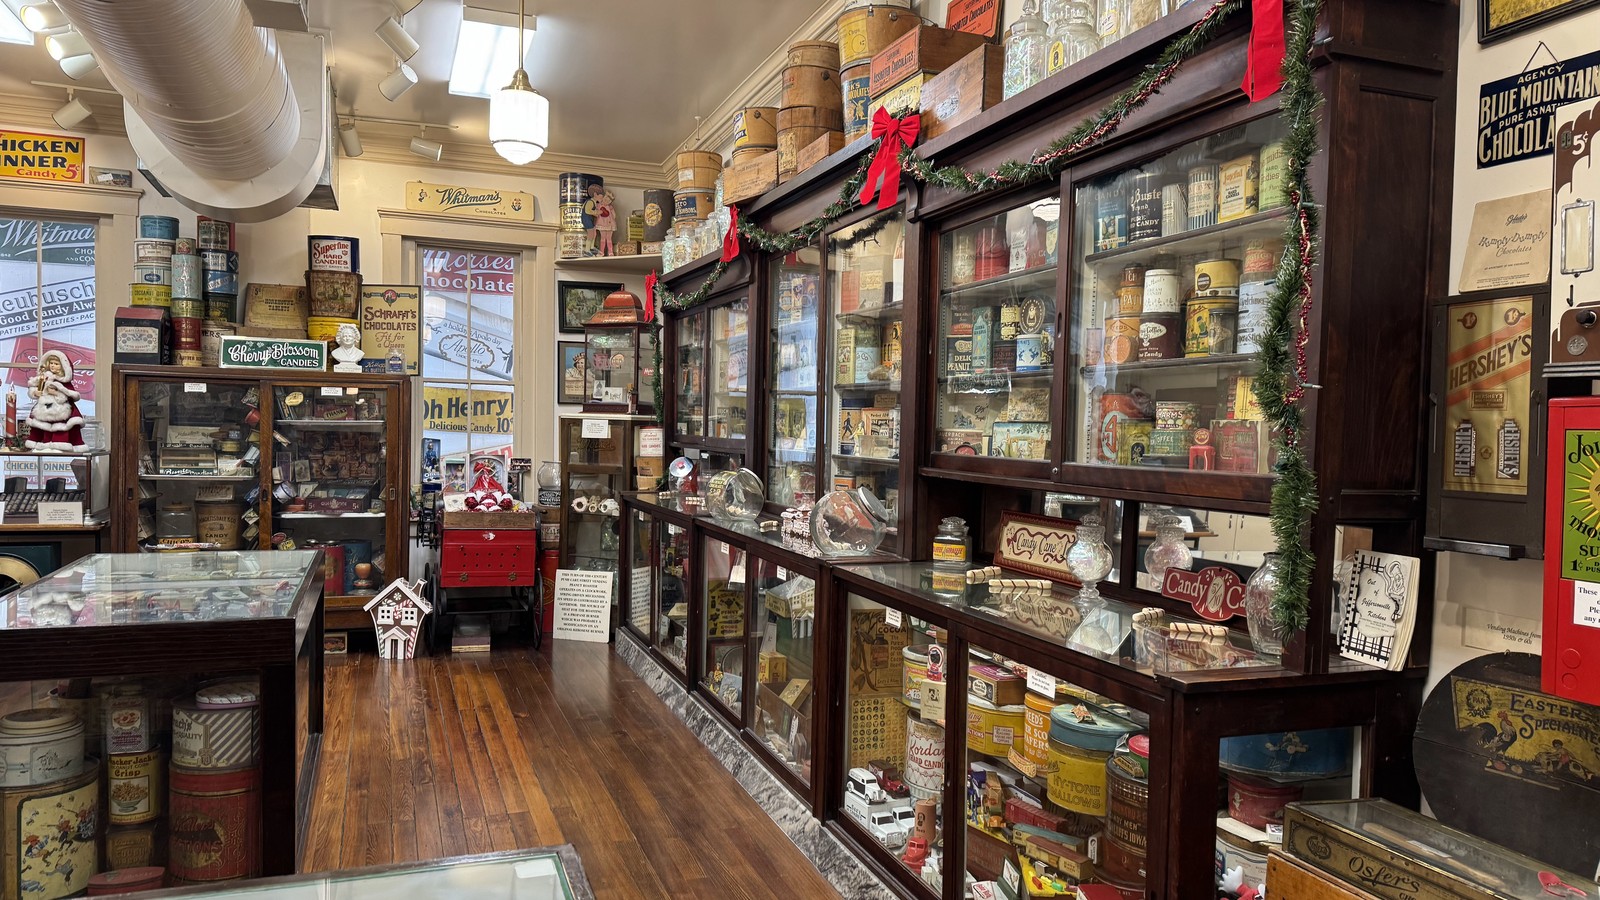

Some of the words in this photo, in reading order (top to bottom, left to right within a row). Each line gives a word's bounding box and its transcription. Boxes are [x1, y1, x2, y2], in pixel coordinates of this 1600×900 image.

[891, 50, 914, 73] CHOCOLATES
[1517, 64, 1565, 84] AGENCY
[1480, 88, 1518, 129] BLUE
[1499, 112, 1524, 129] PURE
[1526, 107, 1538, 118] AS
[1572, 131, 1589, 156] 5¢
[0, 155, 67, 168] NNER
[16, 168, 57, 179] Candy
[436, 187, 502, 206] Whitman's
[1136, 219, 1160, 227] CANDY
[0, 219, 95, 248] Whitma
[1478, 236, 1511, 249] Humpty
[1511, 230, 1548, 244] Dumpty
[313, 241, 350, 260] Superfine
[1496, 245, 1532, 257] Chocolates
[0, 312, 30, 325] Good
[363, 321, 417, 331] CHOCOLATES
[375, 331, 392, 343] Fit
[393, 332, 405, 343] for
[384, 340, 406, 349] Queen
[228, 344, 271, 366] Cherry
[271, 342, 319, 359] Blossom
[443, 339, 486, 356] Apllo
[280, 359, 319, 367] CANDIES
[947, 363, 971, 371] PEANUT
[1450, 334, 1532, 391] HERSHEY'S
[325, 408, 348, 418] THANKS
[430, 420, 468, 431] Delicious
[1568, 515, 1600, 541] THO
[1017, 533, 1038, 550] Candy
[1039, 538, 1057, 556] Cane
[1166, 572, 1207, 606] Candy
[1578, 587, 1598, 596] These
[1584, 615, 1597, 624] any
[878, 626, 907, 634] COCOA
[1510, 693, 1589, 721] EASTER
[114, 769, 142, 777] Crisp
